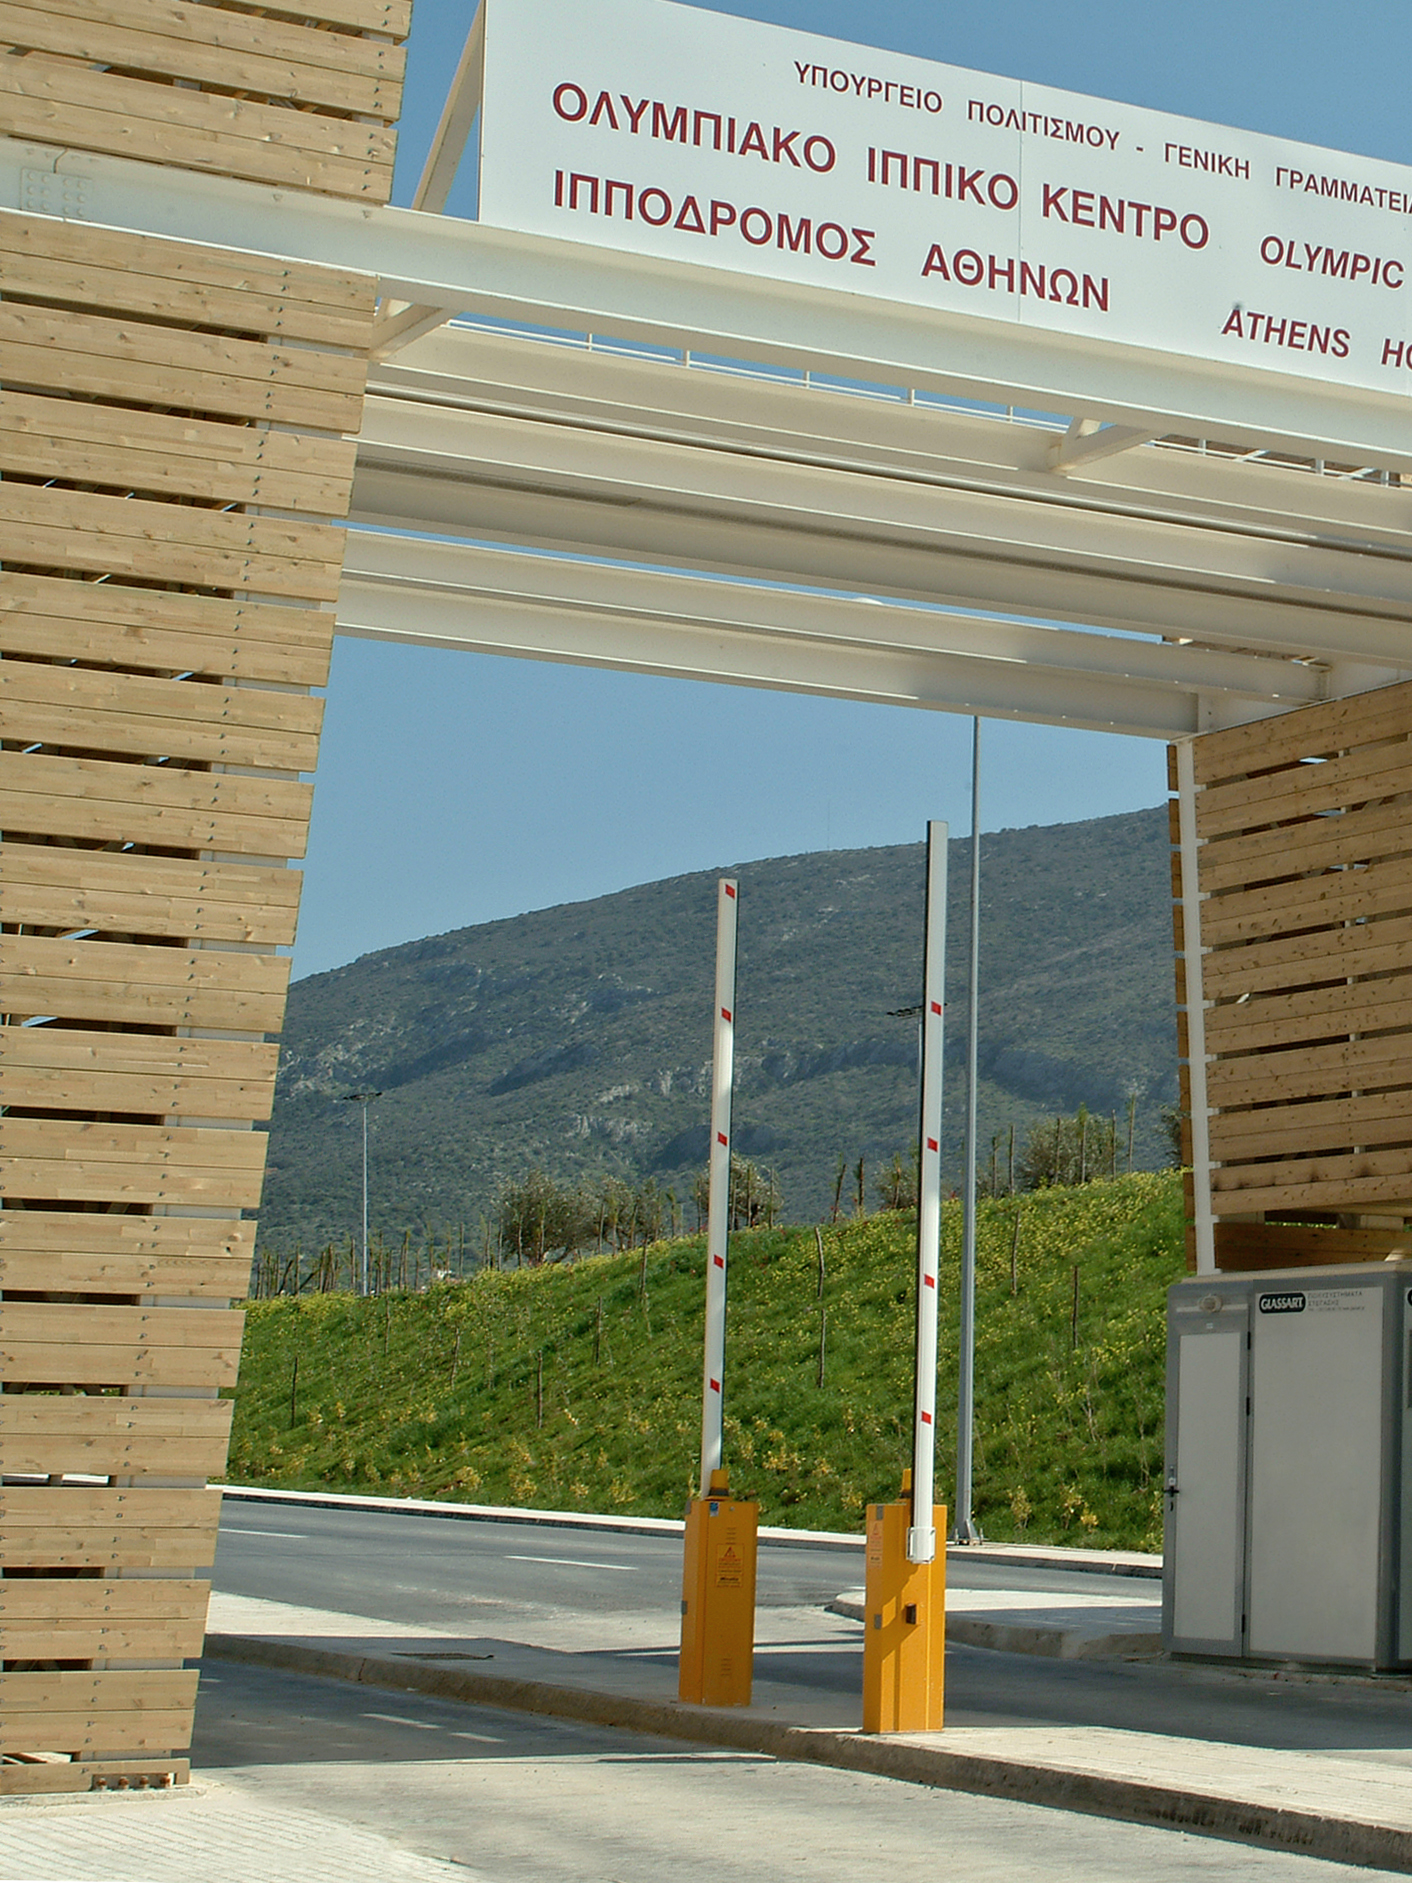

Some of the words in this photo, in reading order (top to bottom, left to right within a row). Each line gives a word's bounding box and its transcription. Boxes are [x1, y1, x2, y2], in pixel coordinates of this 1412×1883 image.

[794, 61, 943, 114] ΥΠΟΥΡΓΕΙΟ
[967, 99, 1121, 151] ΠΟΛΙΤΙΣΜΟΥ
[1164, 142, 1250, 180] ΓΕΝΙΚΗ
[552, 81, 837, 174] ΟΛΥΜΠΙΑΚΟ
[866, 146, 1018, 211] ΙΠΠΙΚΟ
[1041, 182, 1210, 251] ΚΕΝΤΡΟ
[554, 169, 877, 268] ΙΠΠΟΔΡΟΜΟΣ
[920, 243, 1110, 313] ΑΘΗΝΩΝ
[1259, 235, 1405, 290] OLYMPIC
[1220, 308, 1352, 359] ATHENS
[1260, 1296, 1305, 1310] GLASSART
